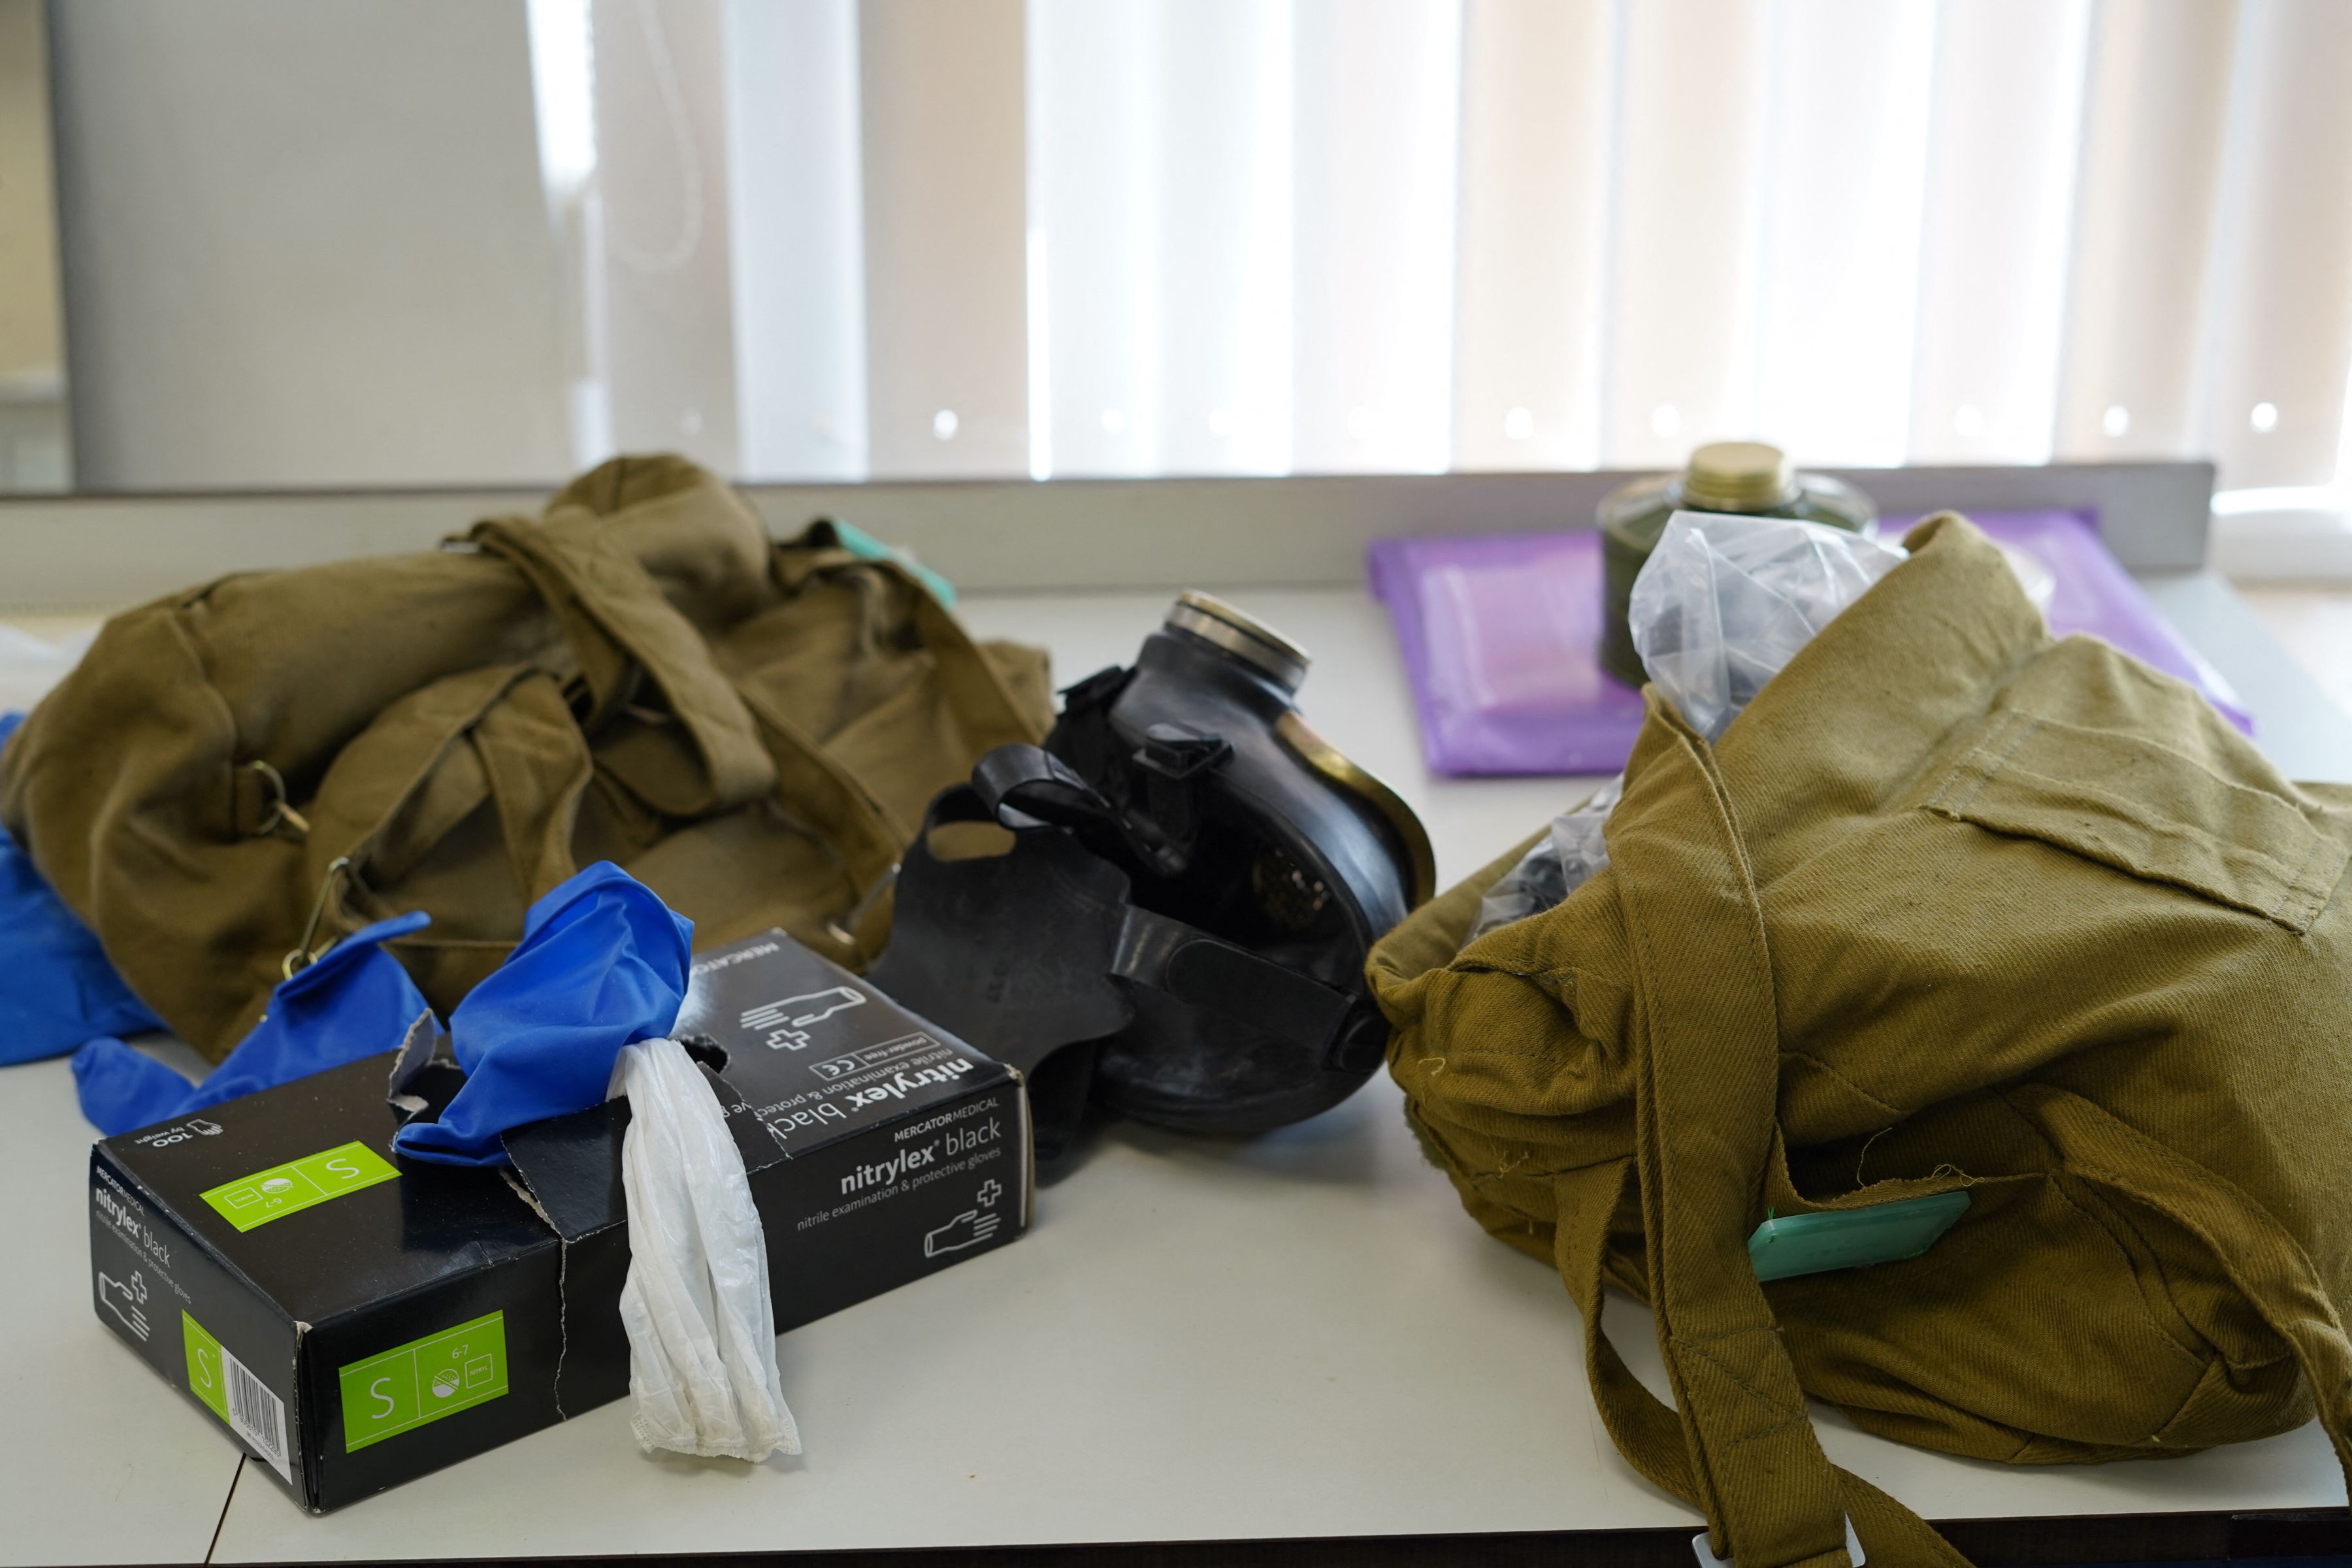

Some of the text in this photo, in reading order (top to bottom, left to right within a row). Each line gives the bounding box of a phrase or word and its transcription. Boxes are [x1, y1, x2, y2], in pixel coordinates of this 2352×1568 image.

[913, 1048, 953, 1066] nitrile
[823, 1063, 909, 1095] examination
[808, 1091, 823, 1100] &
[152, 1132, 193, 1147] 100
[946, 1117, 1002, 1156] black
[327, 1158, 360, 1179] S
[797, 1147, 1002, 1231] nitrile examination & protective gloves
[265, 1198, 282, 1208] 6-7
[144, 1226, 171, 1268] black
[452, 1345, 469, 1359] 6-7
[197, 1348, 213, 1388] S
[370, 1377, 394, 1419] S
